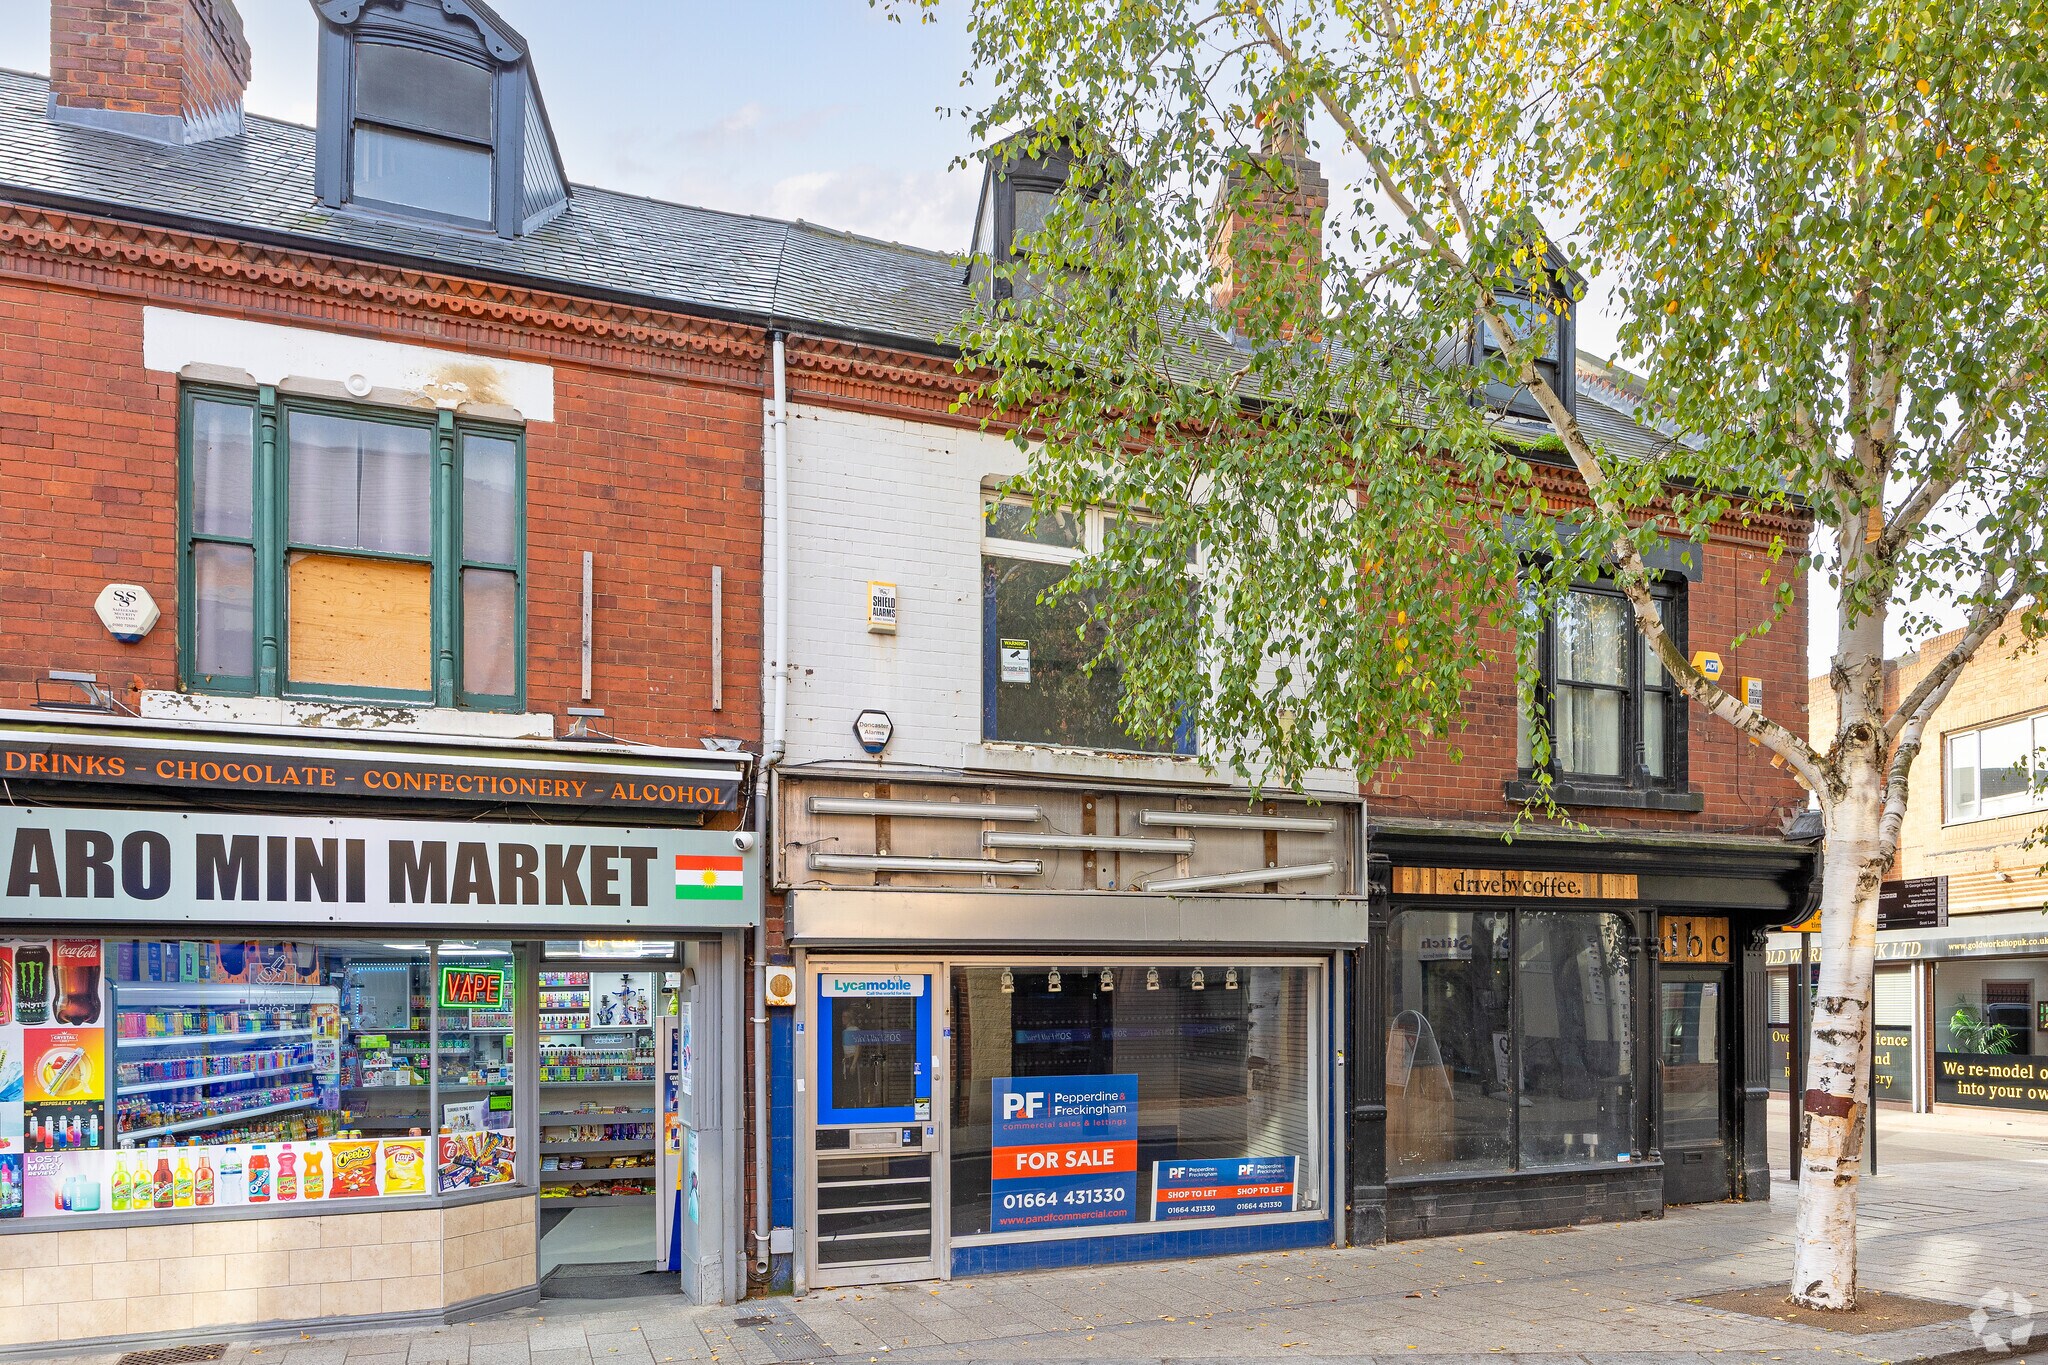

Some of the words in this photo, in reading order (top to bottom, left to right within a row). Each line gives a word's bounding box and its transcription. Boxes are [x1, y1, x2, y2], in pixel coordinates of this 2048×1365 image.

[872, 595, 896, 608] SHIELD
[872, 607, 896, 618] ALARMS
[1705, 662, 1718, 671] ADT
[859, 721, 889, 729] Doncaster
[5, 751, 126, 777] DRINKS
[156, 760, 337, 787] CHOCOLATE
[364, 770, 588, 798] CONFECTIONERY
[611, 782, 727, 806] ALCOHOL
[6, 827, 172, 900] ARO
[196, 833, 366, 903] MINI
[388, 839, 658, 907] MARKET
[57, 944, 98, 958] Coca-Cola
[1892, 941, 1922, 958] LTD
[448, 973, 501, 1002] VAPE
[834, 979, 912, 992] Lycamobile
[1943, 1061, 1965, 1075] We
[1968, 1063, 2034, 1079] re-model
[1957, 1080, 1985, 1096] into
[1988, 1084, 2023, 1100] your
[1054, 1091, 1119, 1104] Pepperdine
[1119, 1092, 1126, 1100] &
[1054, 1103, 1127, 1116] Freckingham
[1002, 1121, 1055, 1130] commercial
[1058, 1120, 1081, 1128] sales
[1093, 1118, 1127, 1128] lettings
[27, 1155, 62, 1164] LOST
[337, 1146, 372, 1168] Cheetos
[1016, 1152, 1059, 1171] FOR
[1065, 1148, 1114, 1167] SALE
[27, 1162, 64, 1172] MARY
[249, 1170, 270, 1195] Oasis
[1167, 1191, 1190, 1199] SHOP
[1191, 1190, 1202, 1198] TO
[1203, 1189, 1217, 1197] LET
[1259, 1186, 1270, 1194] TO
[1271, 1185, 1284, 1193] LET
[1003, 1192, 1058, 1209] 01664
[1063, 1187, 1126, 1205] 431330
[1167, 1206, 1189, 1214] 01664
[1236, 1202, 1257, 1210] 01664
[999, 1208, 1127, 1225] www.pandfcommercial.com
